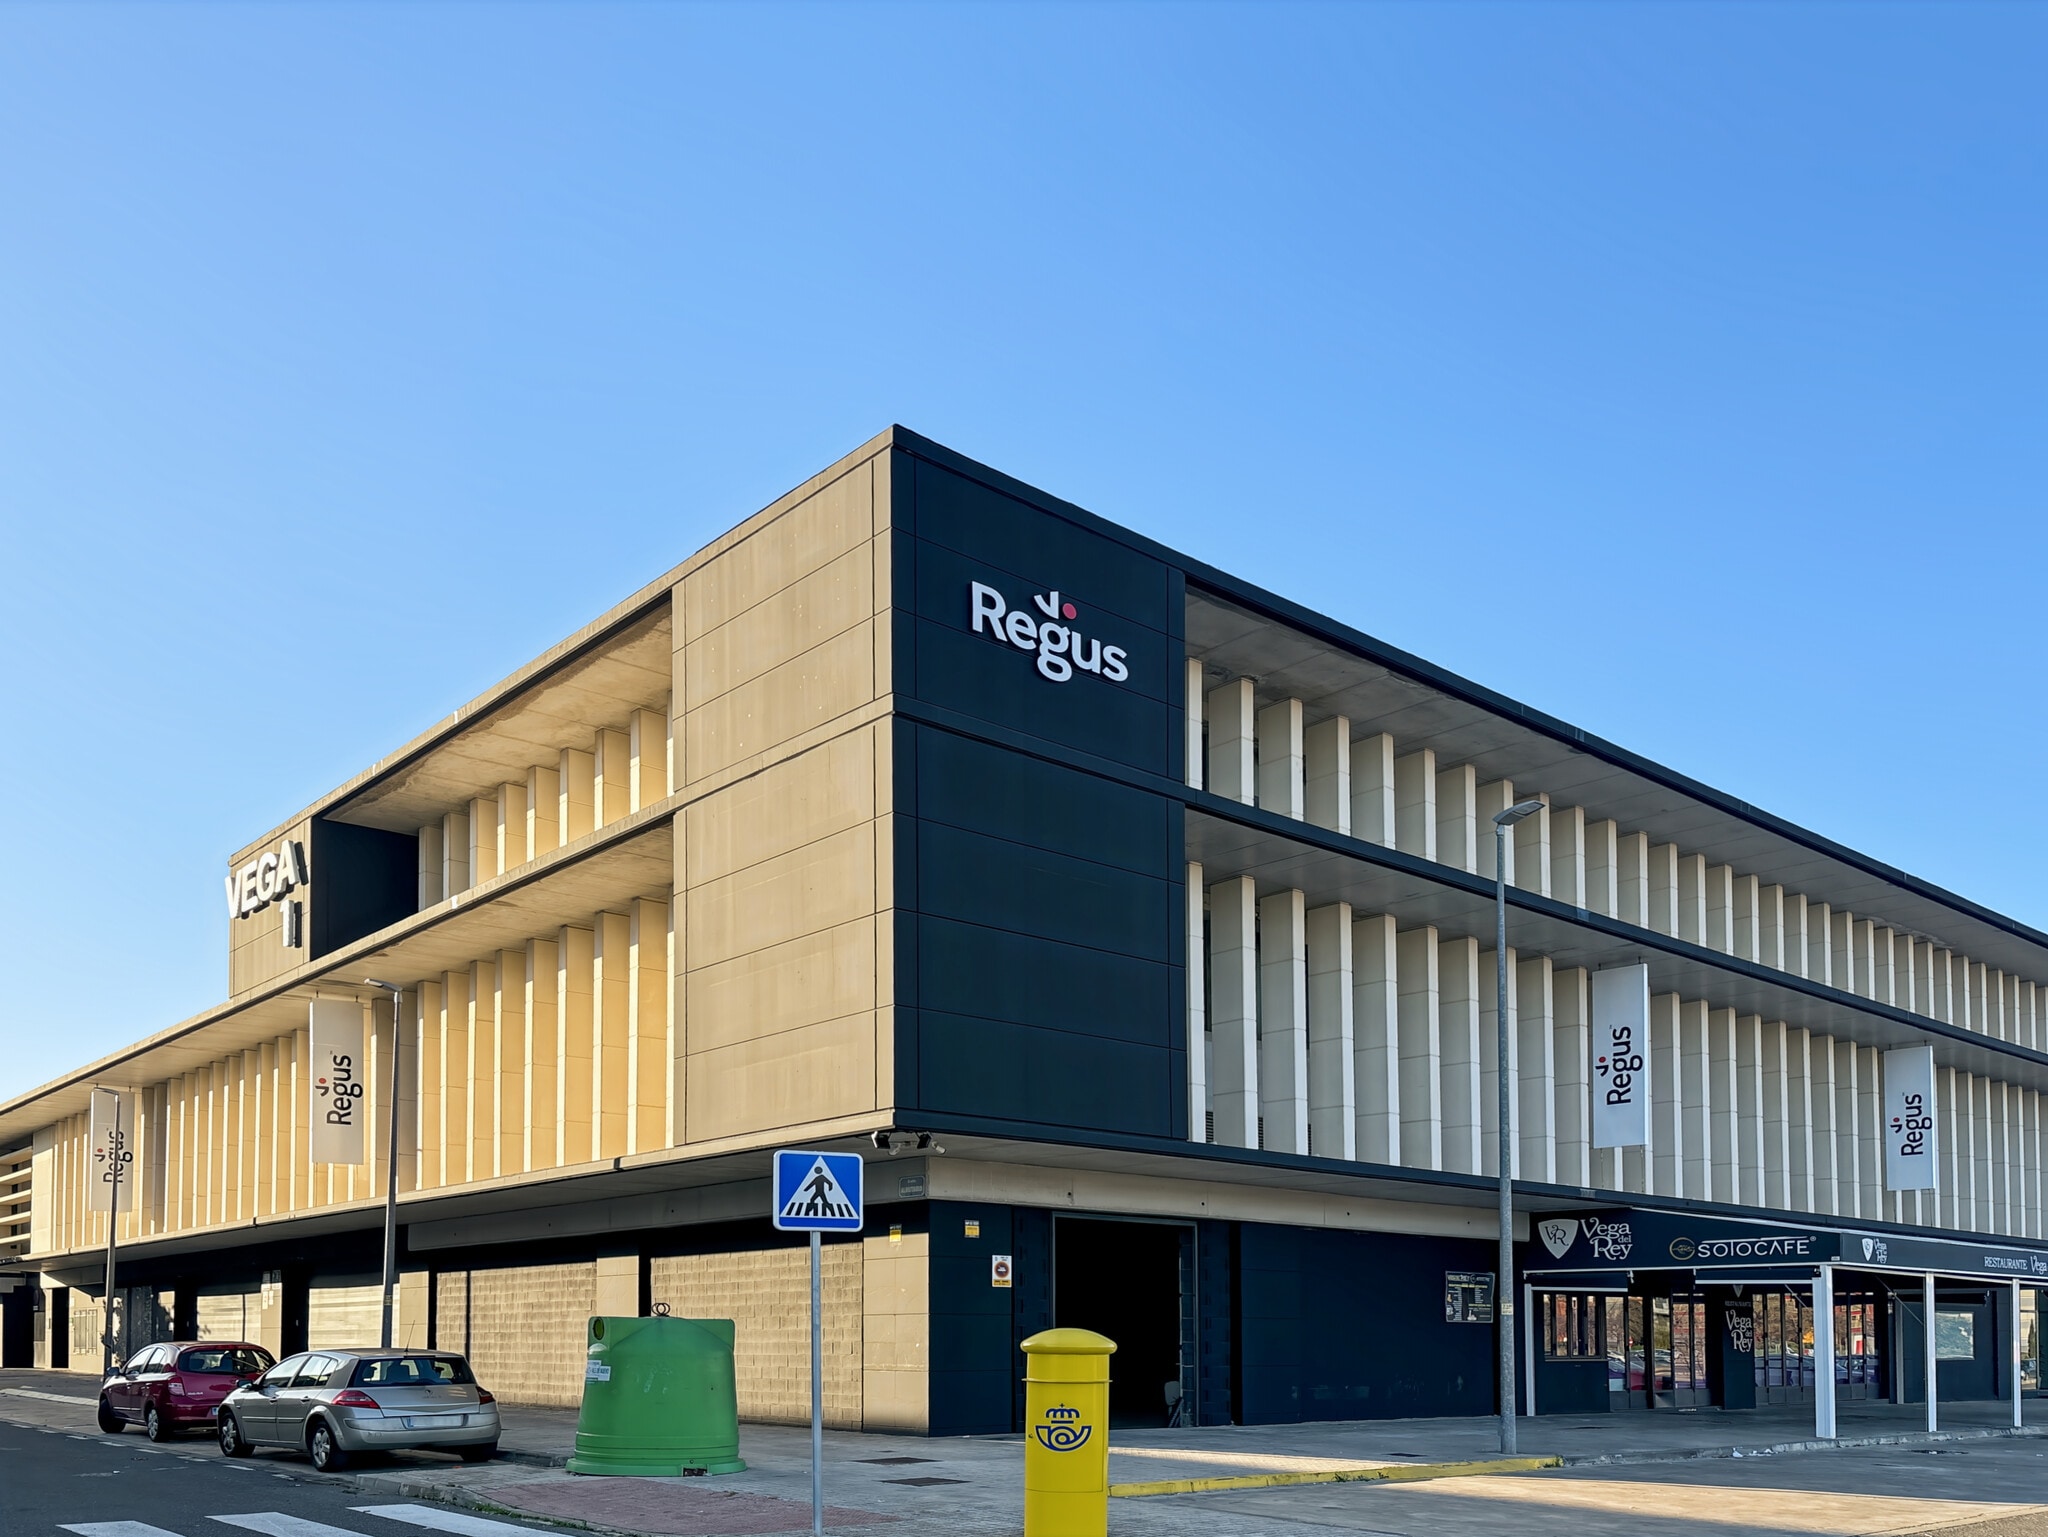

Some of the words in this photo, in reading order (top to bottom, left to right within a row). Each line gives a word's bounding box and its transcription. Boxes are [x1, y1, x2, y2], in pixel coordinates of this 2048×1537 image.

[972, 580, 1129, 682] Regus
[225, 839, 300, 919] VEGA
[279, 899, 295, 947] 1
[1606, 1026, 1643, 1106] Regus
[326, 1055, 363, 1125] Regus
[1901, 1093, 1933, 1156] Regus
[1580, 1217, 1632, 1239] Vega
[1617, 1235, 1632, 1243] del
[1589, 1235, 1633, 1260] Rey
[1698, 1237, 1810, 1257] SOTOCAFE
[1984, 1256, 2028, 1270] RESTAURANTE
[2030, 1255, 2047, 1275] Vega
[1725, 1309, 1752, 1332] Vega
[1731, 1329, 1753, 1352] Rey
